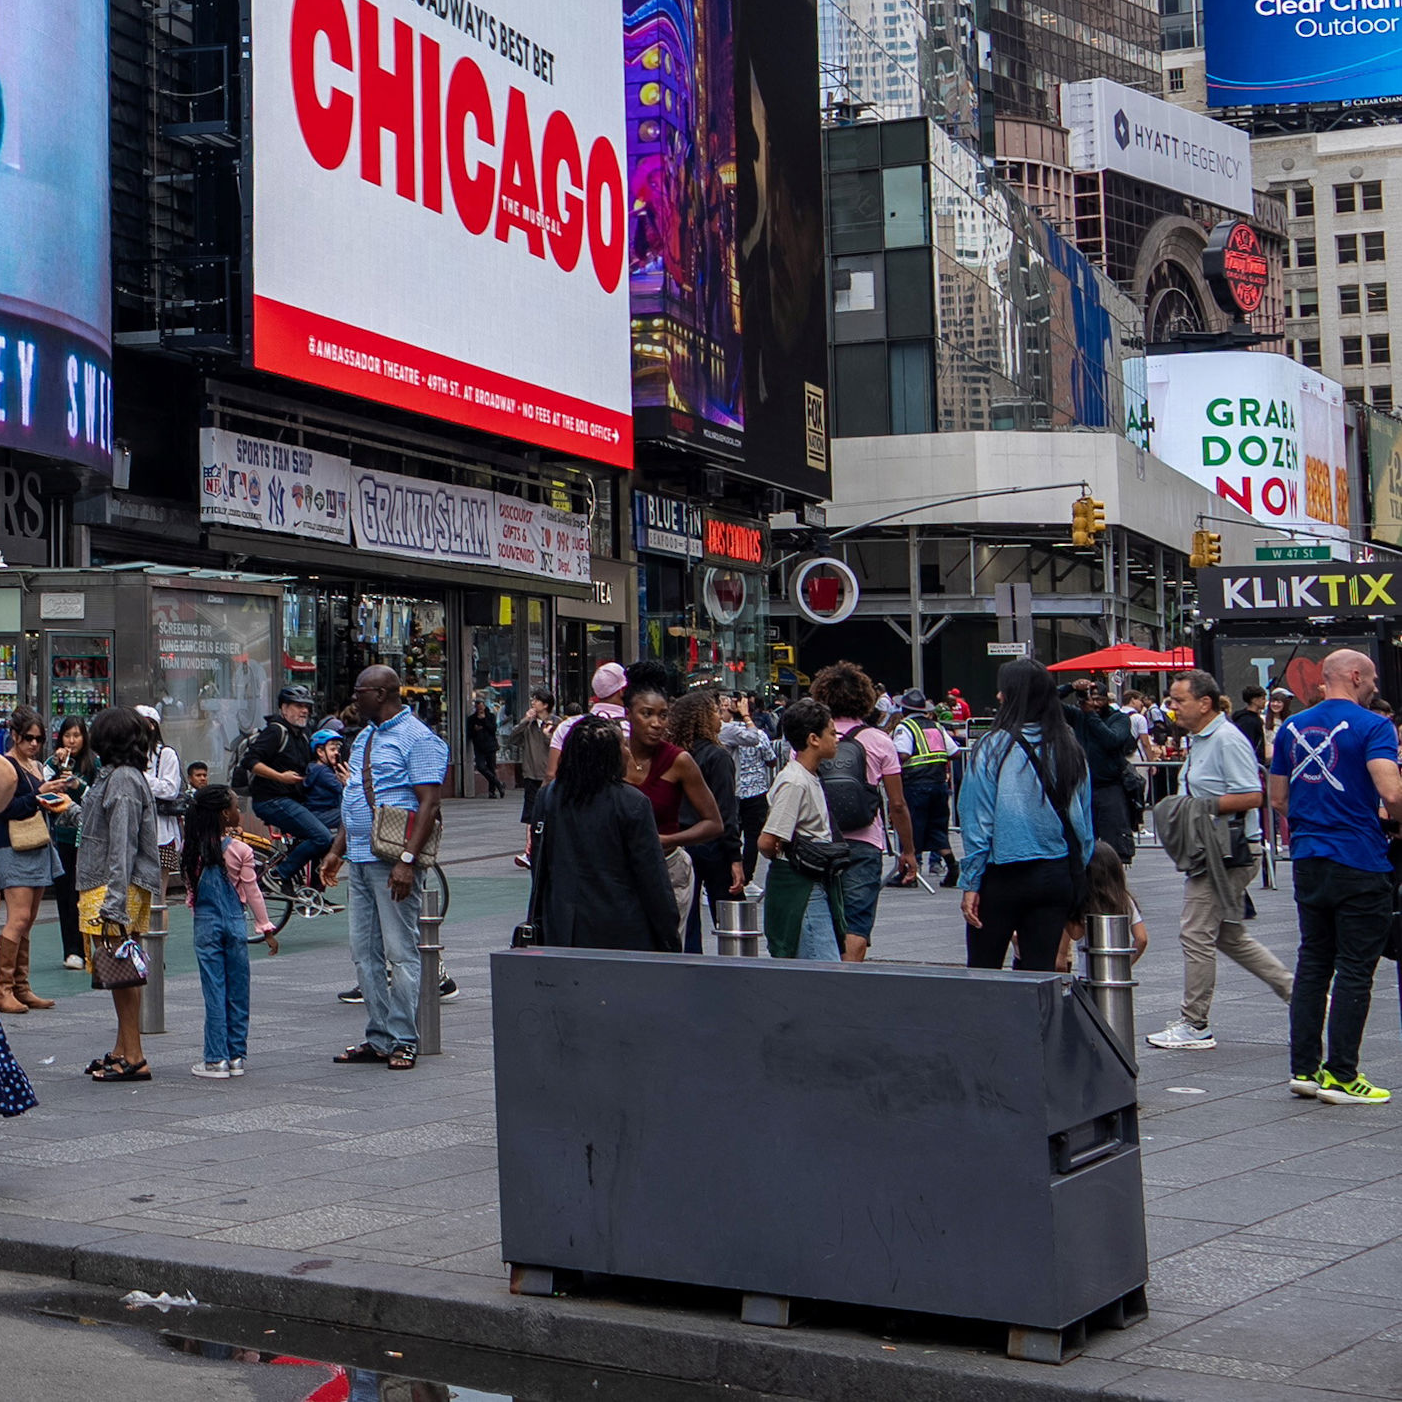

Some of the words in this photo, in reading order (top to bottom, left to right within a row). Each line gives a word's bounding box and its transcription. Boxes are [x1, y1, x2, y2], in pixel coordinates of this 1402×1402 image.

[1295, 16, 1400, 38] Outdoor
[499, 28, 531, 70] BEST
[532, 44, 555, 86] BET
[1135, 124, 1180, 159] HYATT
[1182, 141, 1243, 180] REGENCY
[501, 194, 520, 217] THE
[522, 205, 562, 237] MUSICAL
[316, 340, 382, 374] AMBASSADOR
[382, 360, 421, 386] THEATRE
[426, 374, 447, 394] 49TH
[449, 380, 461, 398] ST.
[463, 384, 474, 401] AT
[474, 388, 517, 414] BROADWAY
[522, 402, 534, 419] NO
[535, 405, 551, 424] FEES
[552, 412, 562, 426] AT
[562, 414, 575, 431] THE
[575, 418, 589, 436] BOX
[589, 423, 612, 442] OFFICE
[807, 395, 824, 431] FOX
[1206, 398, 1289, 430] GRAB
[807, 432, 825, 452] NATION
[1202, 435, 1299, 472] DOZEN
[236, 438, 270, 468] SPORTS
[272, 446, 290, 472] FAN
[292, 448, 313, 476] SHOP
[1216, 476, 1298, 518] NOW
[499, 502, 534, 524] DISCOUNT
[647, 494, 679, 531] BLUE
[502, 524, 521, 541] GIFTS
[649, 531, 679, 549] SEAFOOD
[497, 543, 535, 564] SOUVENIRS
[1272, 549, 1283, 559] W
[1287, 548, 1299, 559] 47
[1302, 548, 1314, 559] St
[592, 581, 612, 604] TEA
[1222, 572, 1396, 610] KLIKTIX
[159, 621, 198, 636] SCREENING
[199, 623, 212, 636] FOR
[215, 642, 240, 655] EASIER
[160, 656, 180, 670] THAN
[181, 657, 221, 670] WONDERING.
